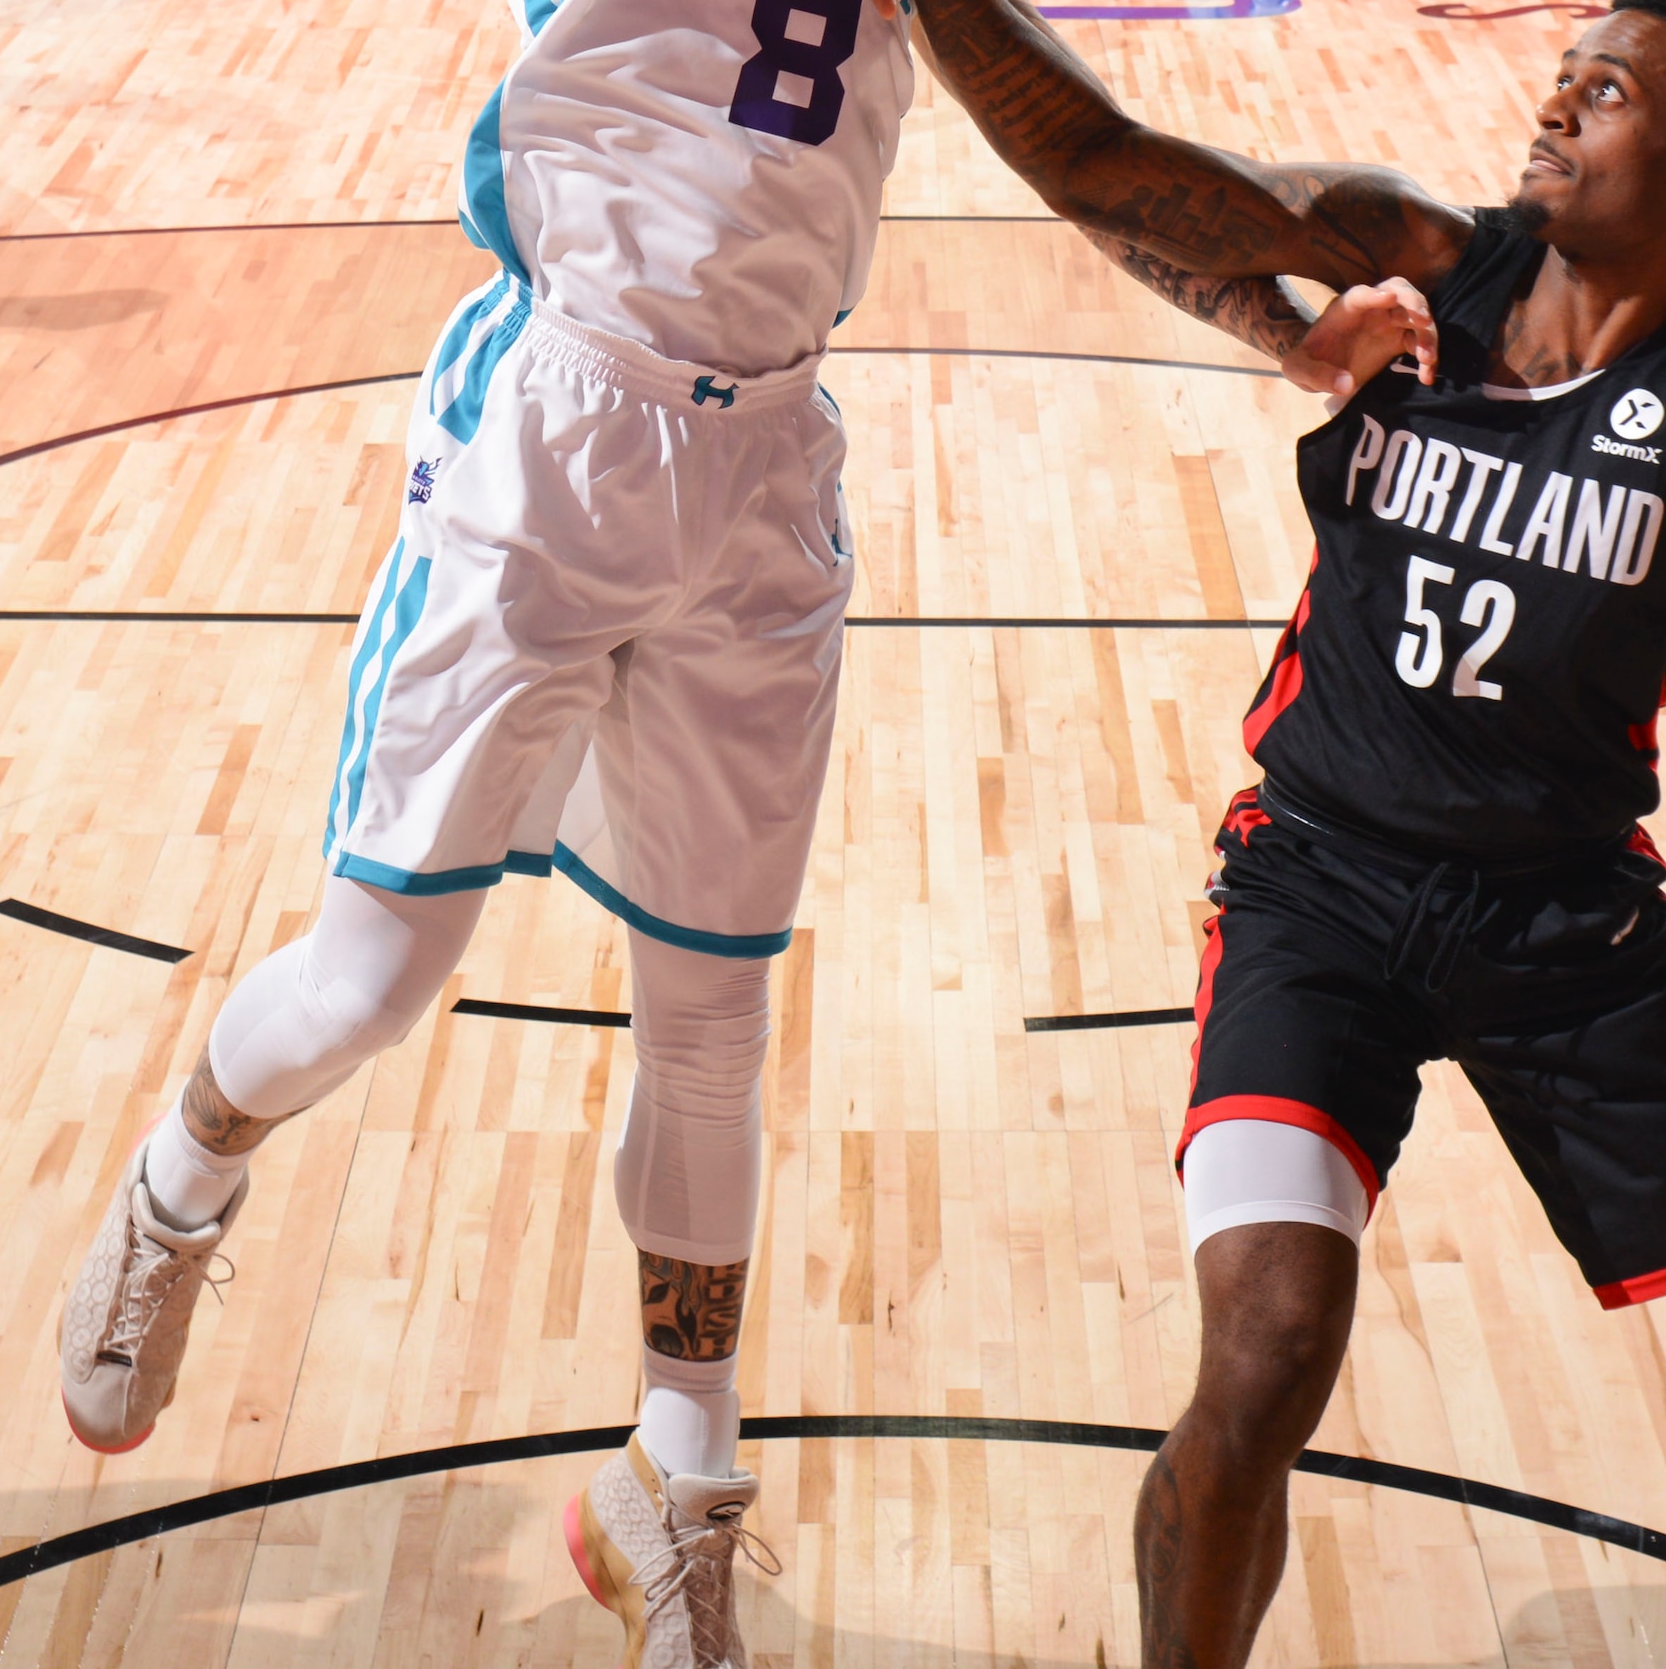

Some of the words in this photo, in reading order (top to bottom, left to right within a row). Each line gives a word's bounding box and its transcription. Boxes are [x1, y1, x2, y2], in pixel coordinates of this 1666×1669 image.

[1345, 413, 1665, 586] PORTLAND
[1590, 434, 1663, 465] StormX
[1394, 554, 1517, 702] 52
